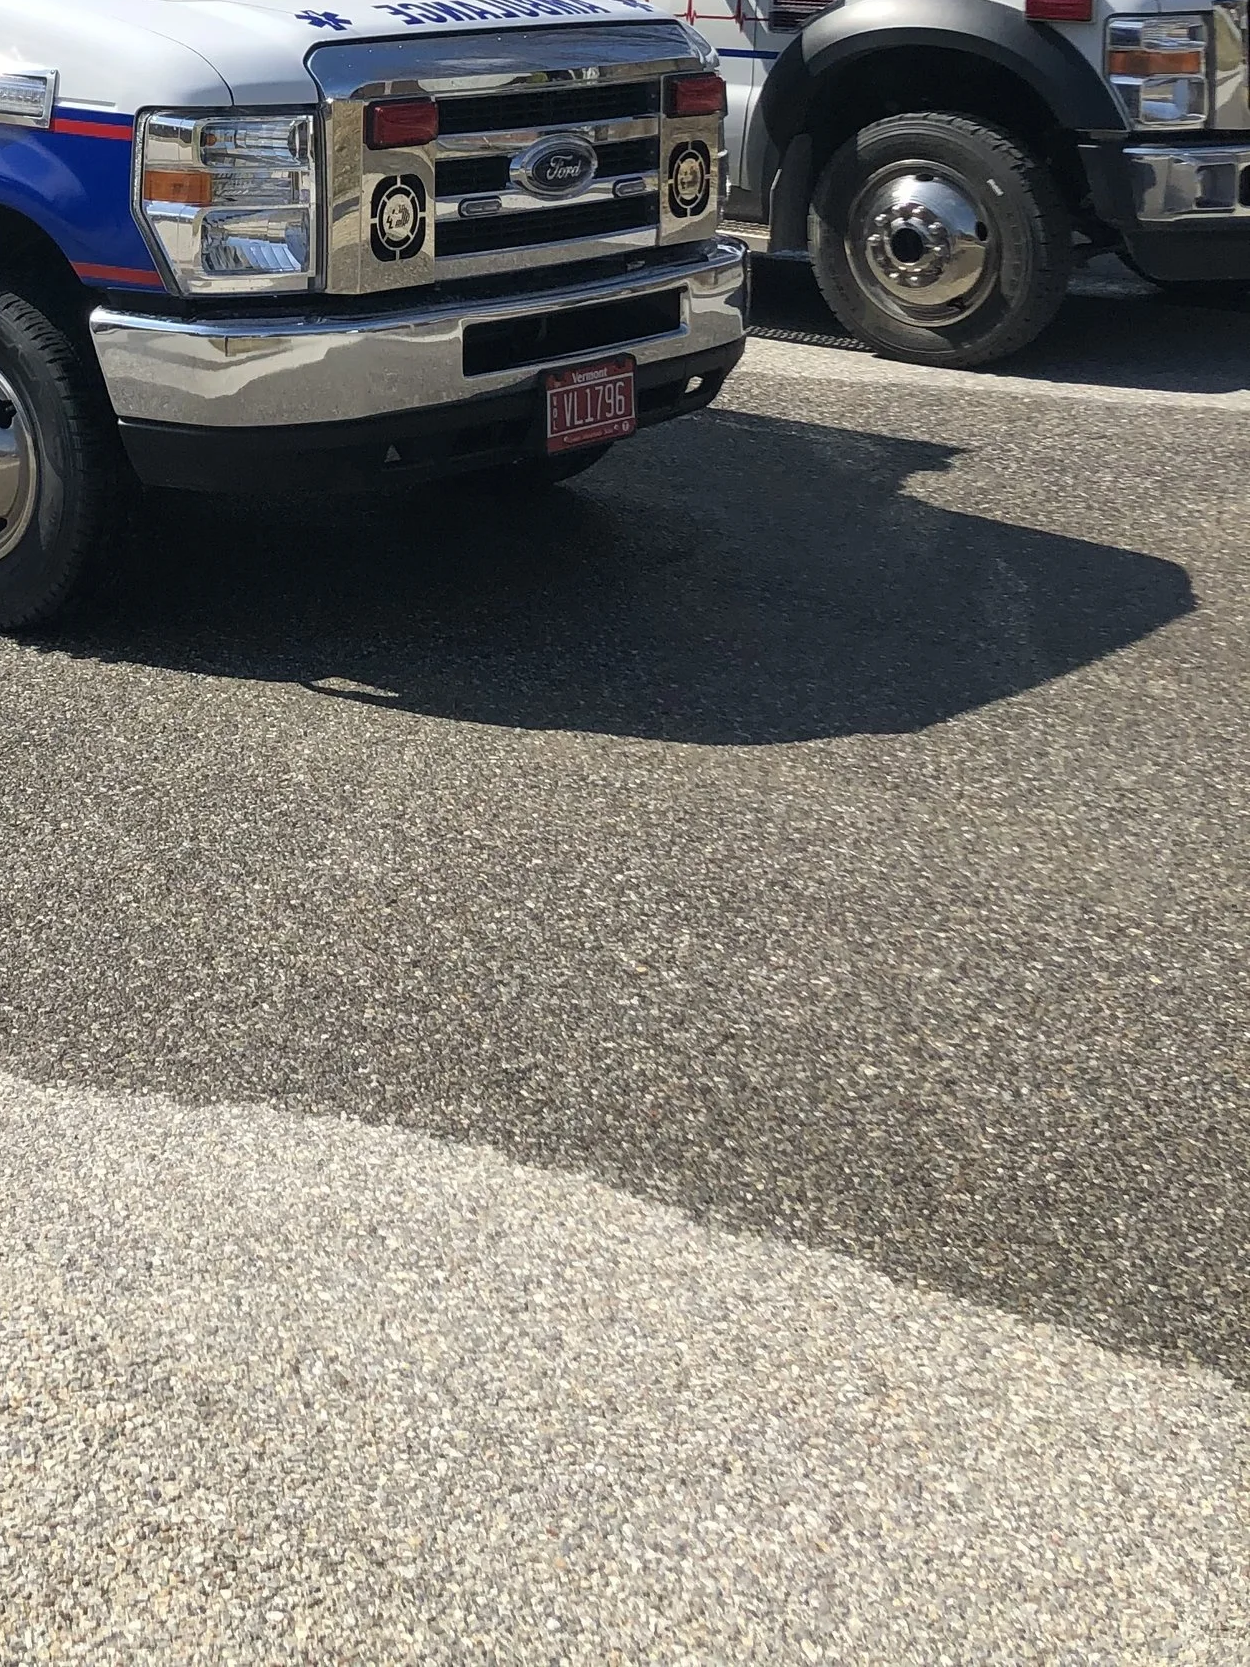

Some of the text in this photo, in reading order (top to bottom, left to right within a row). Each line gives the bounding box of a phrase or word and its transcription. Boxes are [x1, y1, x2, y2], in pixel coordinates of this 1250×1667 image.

[546, 154, 582, 180] Ford
[571, 367, 608, 384] Vermont
[563, 381, 625, 427] VL1796
